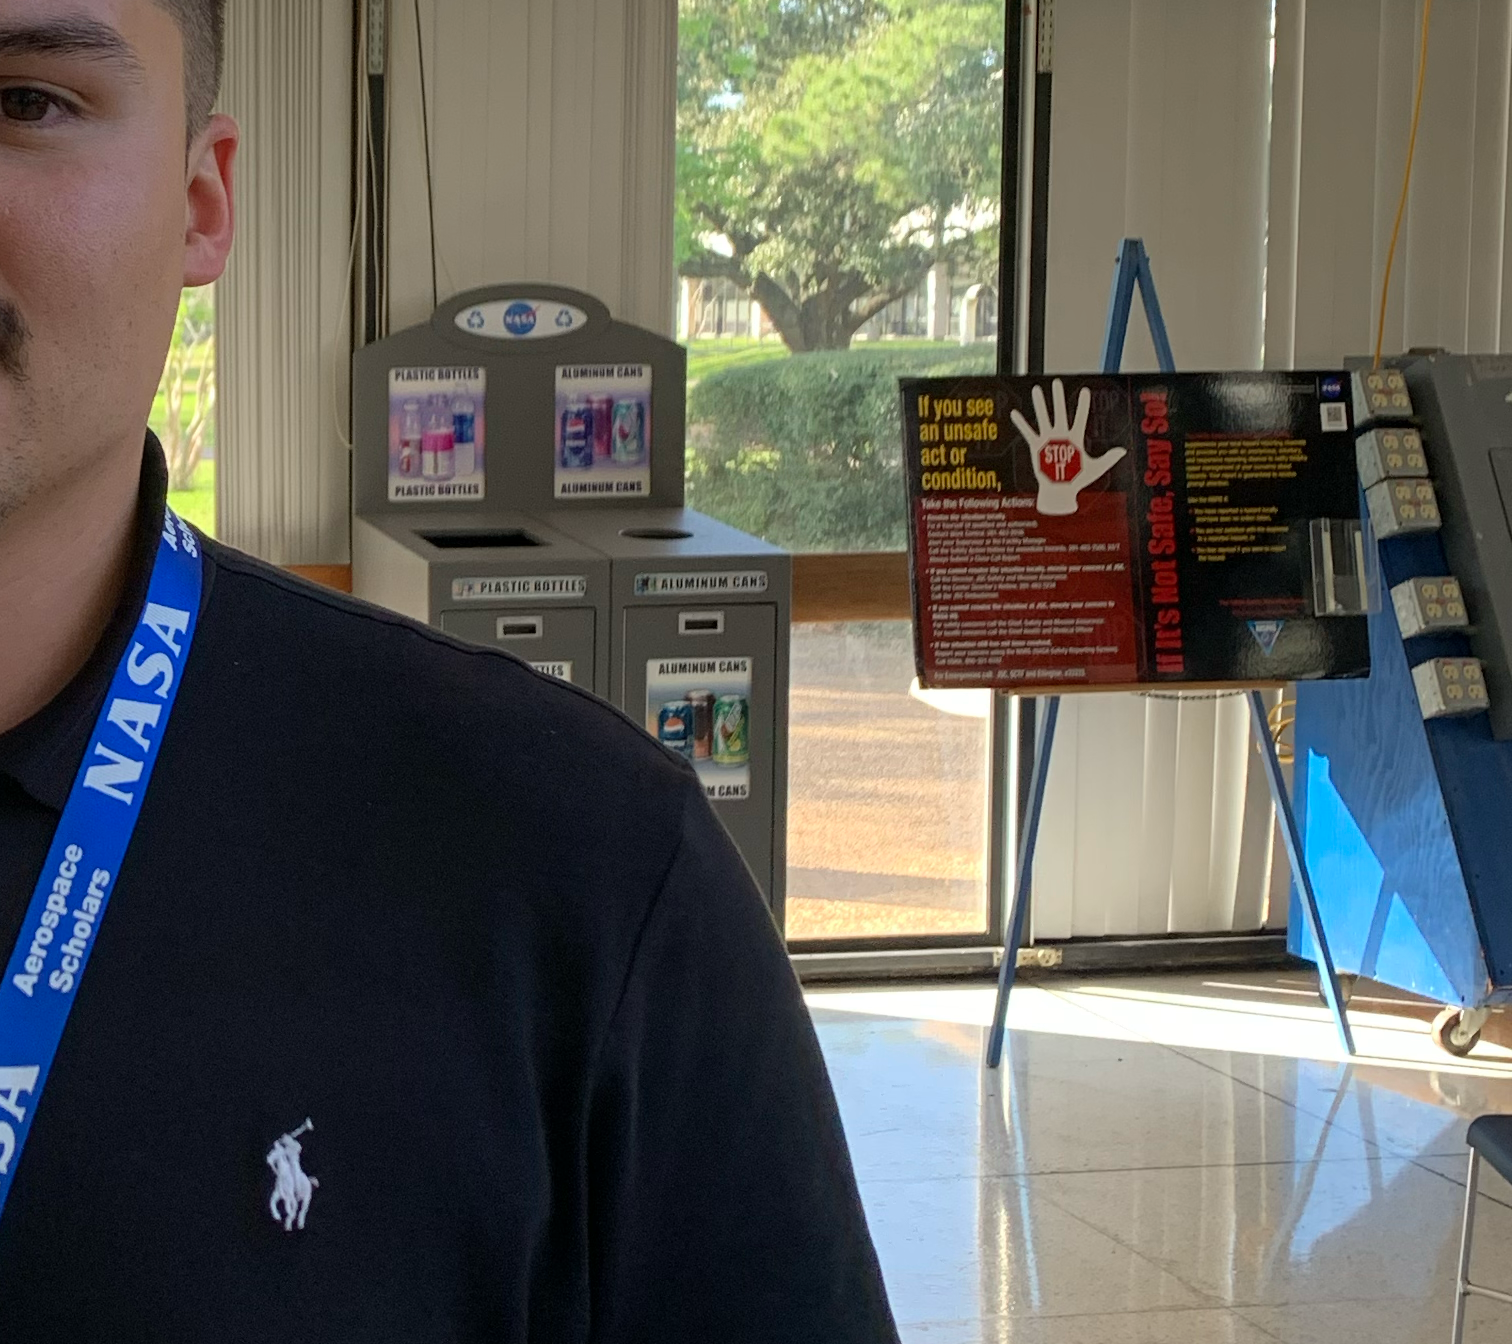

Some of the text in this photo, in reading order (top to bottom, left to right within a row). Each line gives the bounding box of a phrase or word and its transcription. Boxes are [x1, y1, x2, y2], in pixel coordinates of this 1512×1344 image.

[395, 367, 479, 381] PLASTIC BOTTLES
[562, 366, 643, 378] ALUMINUM CANS
[917, 394, 994, 421] If you see
[919, 418, 997, 442] an unsafe
[921, 445, 968, 466] act or
[1044, 444, 1075, 464] STOP
[922, 466, 1002, 492] condition,
[1055, 462, 1065, 480] IT
[395, 484, 479, 496] PLASTIC BOTTLES
[561, 481, 642, 494] ALUMINUM CANS
[1139, 388, 1184, 672] If It's Not Safe, Say So!
[480, 579, 586, 593] PLASTIC BOTTLES
[661, 575, 767, 590] ALUMINUM CANS
[658, 660, 748, 675] ALUMINUM CANS
[83, 602, 190, 805] NASA
[718, 784, 747, 796] CANS
[12, 844, 83, 998] Aerospace
[48, 867, 111, 994] Scholars
